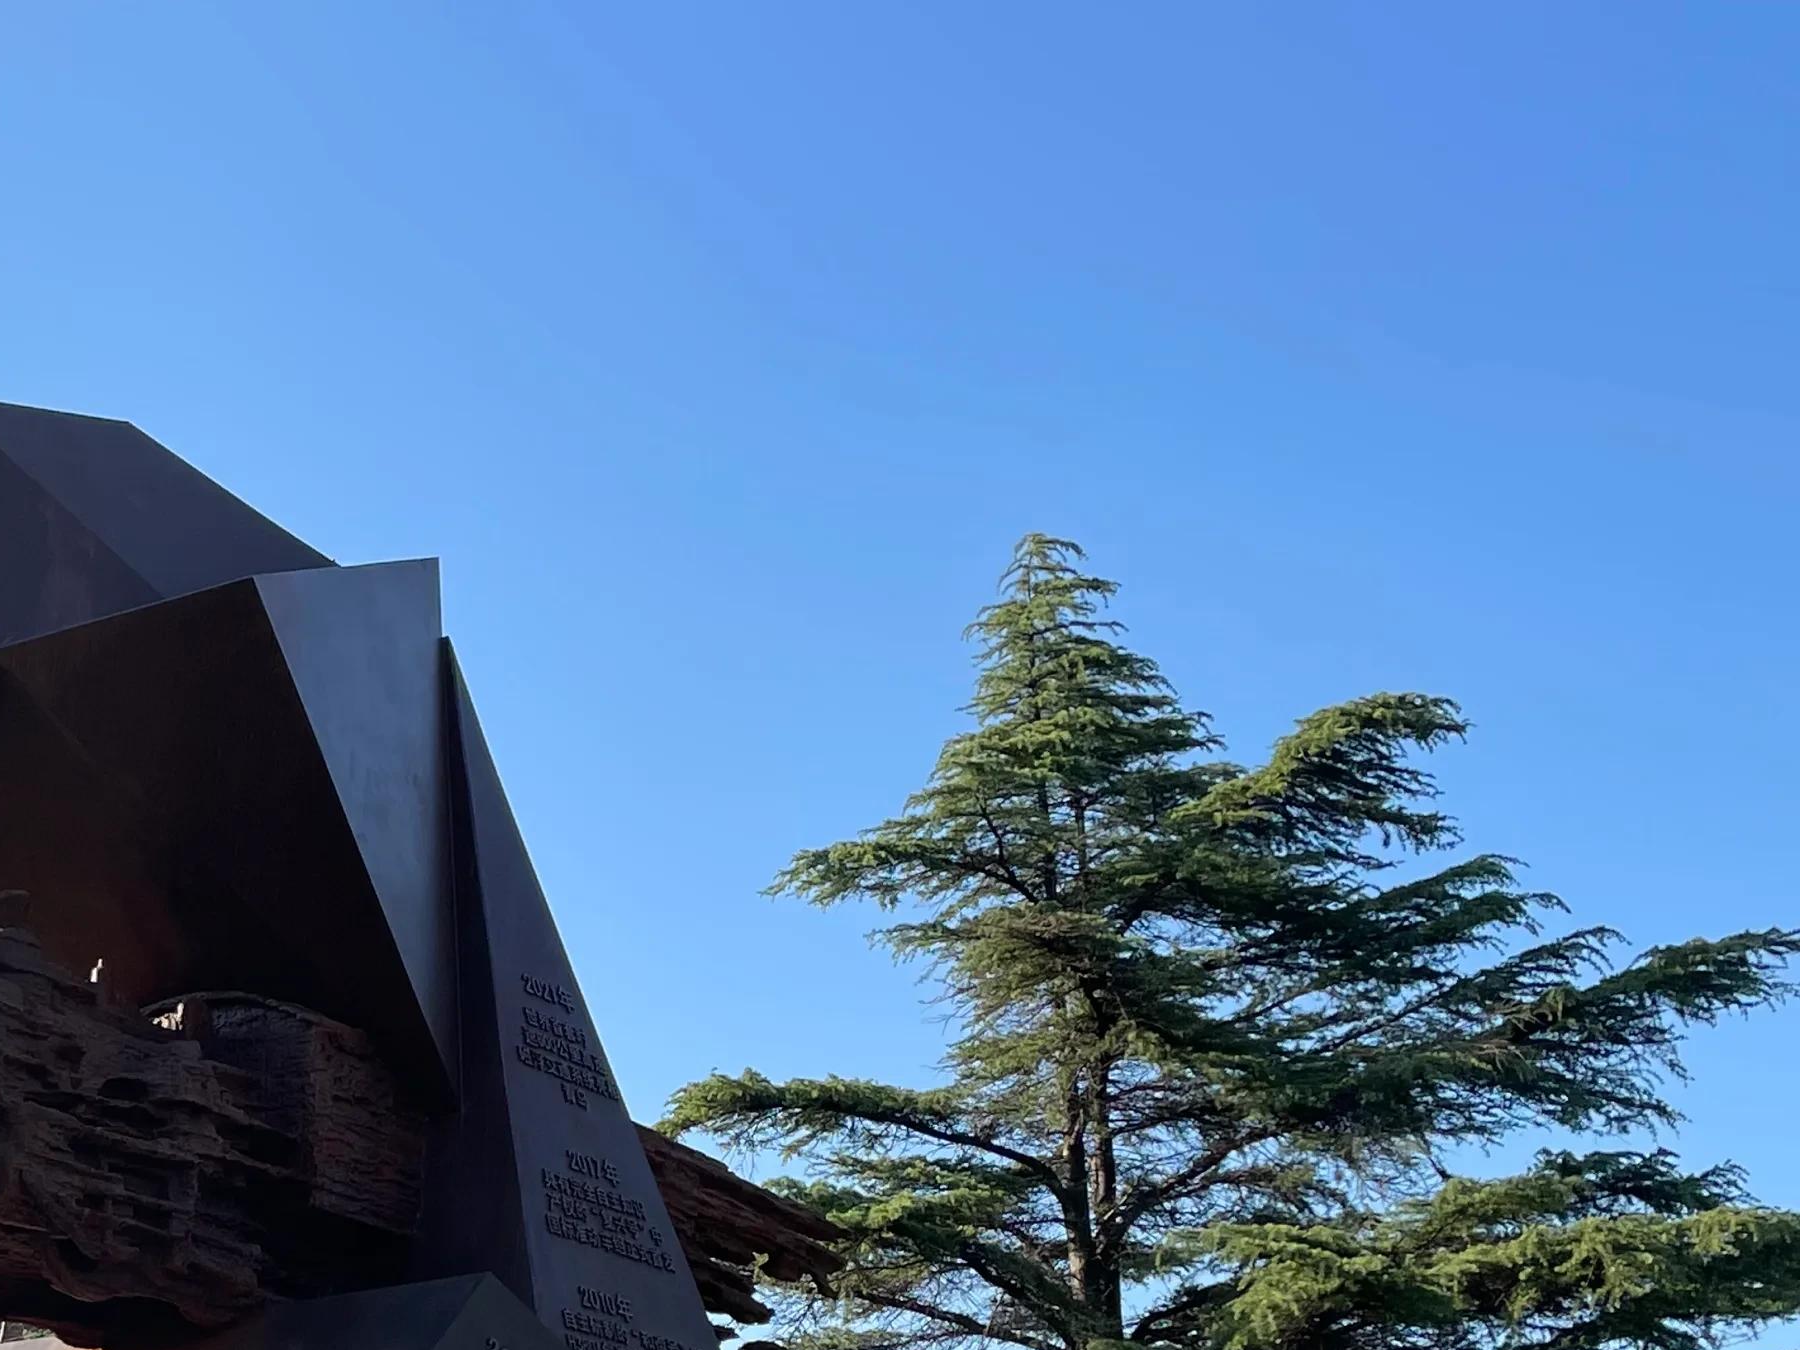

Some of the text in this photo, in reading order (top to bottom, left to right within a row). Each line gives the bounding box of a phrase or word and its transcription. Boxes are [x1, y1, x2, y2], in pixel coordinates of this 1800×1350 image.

[521, 972, 576, 1014] 2021年
[565, 1148, 620, 1187] 2017年
[577, 1287, 634, 1321] 2010年
